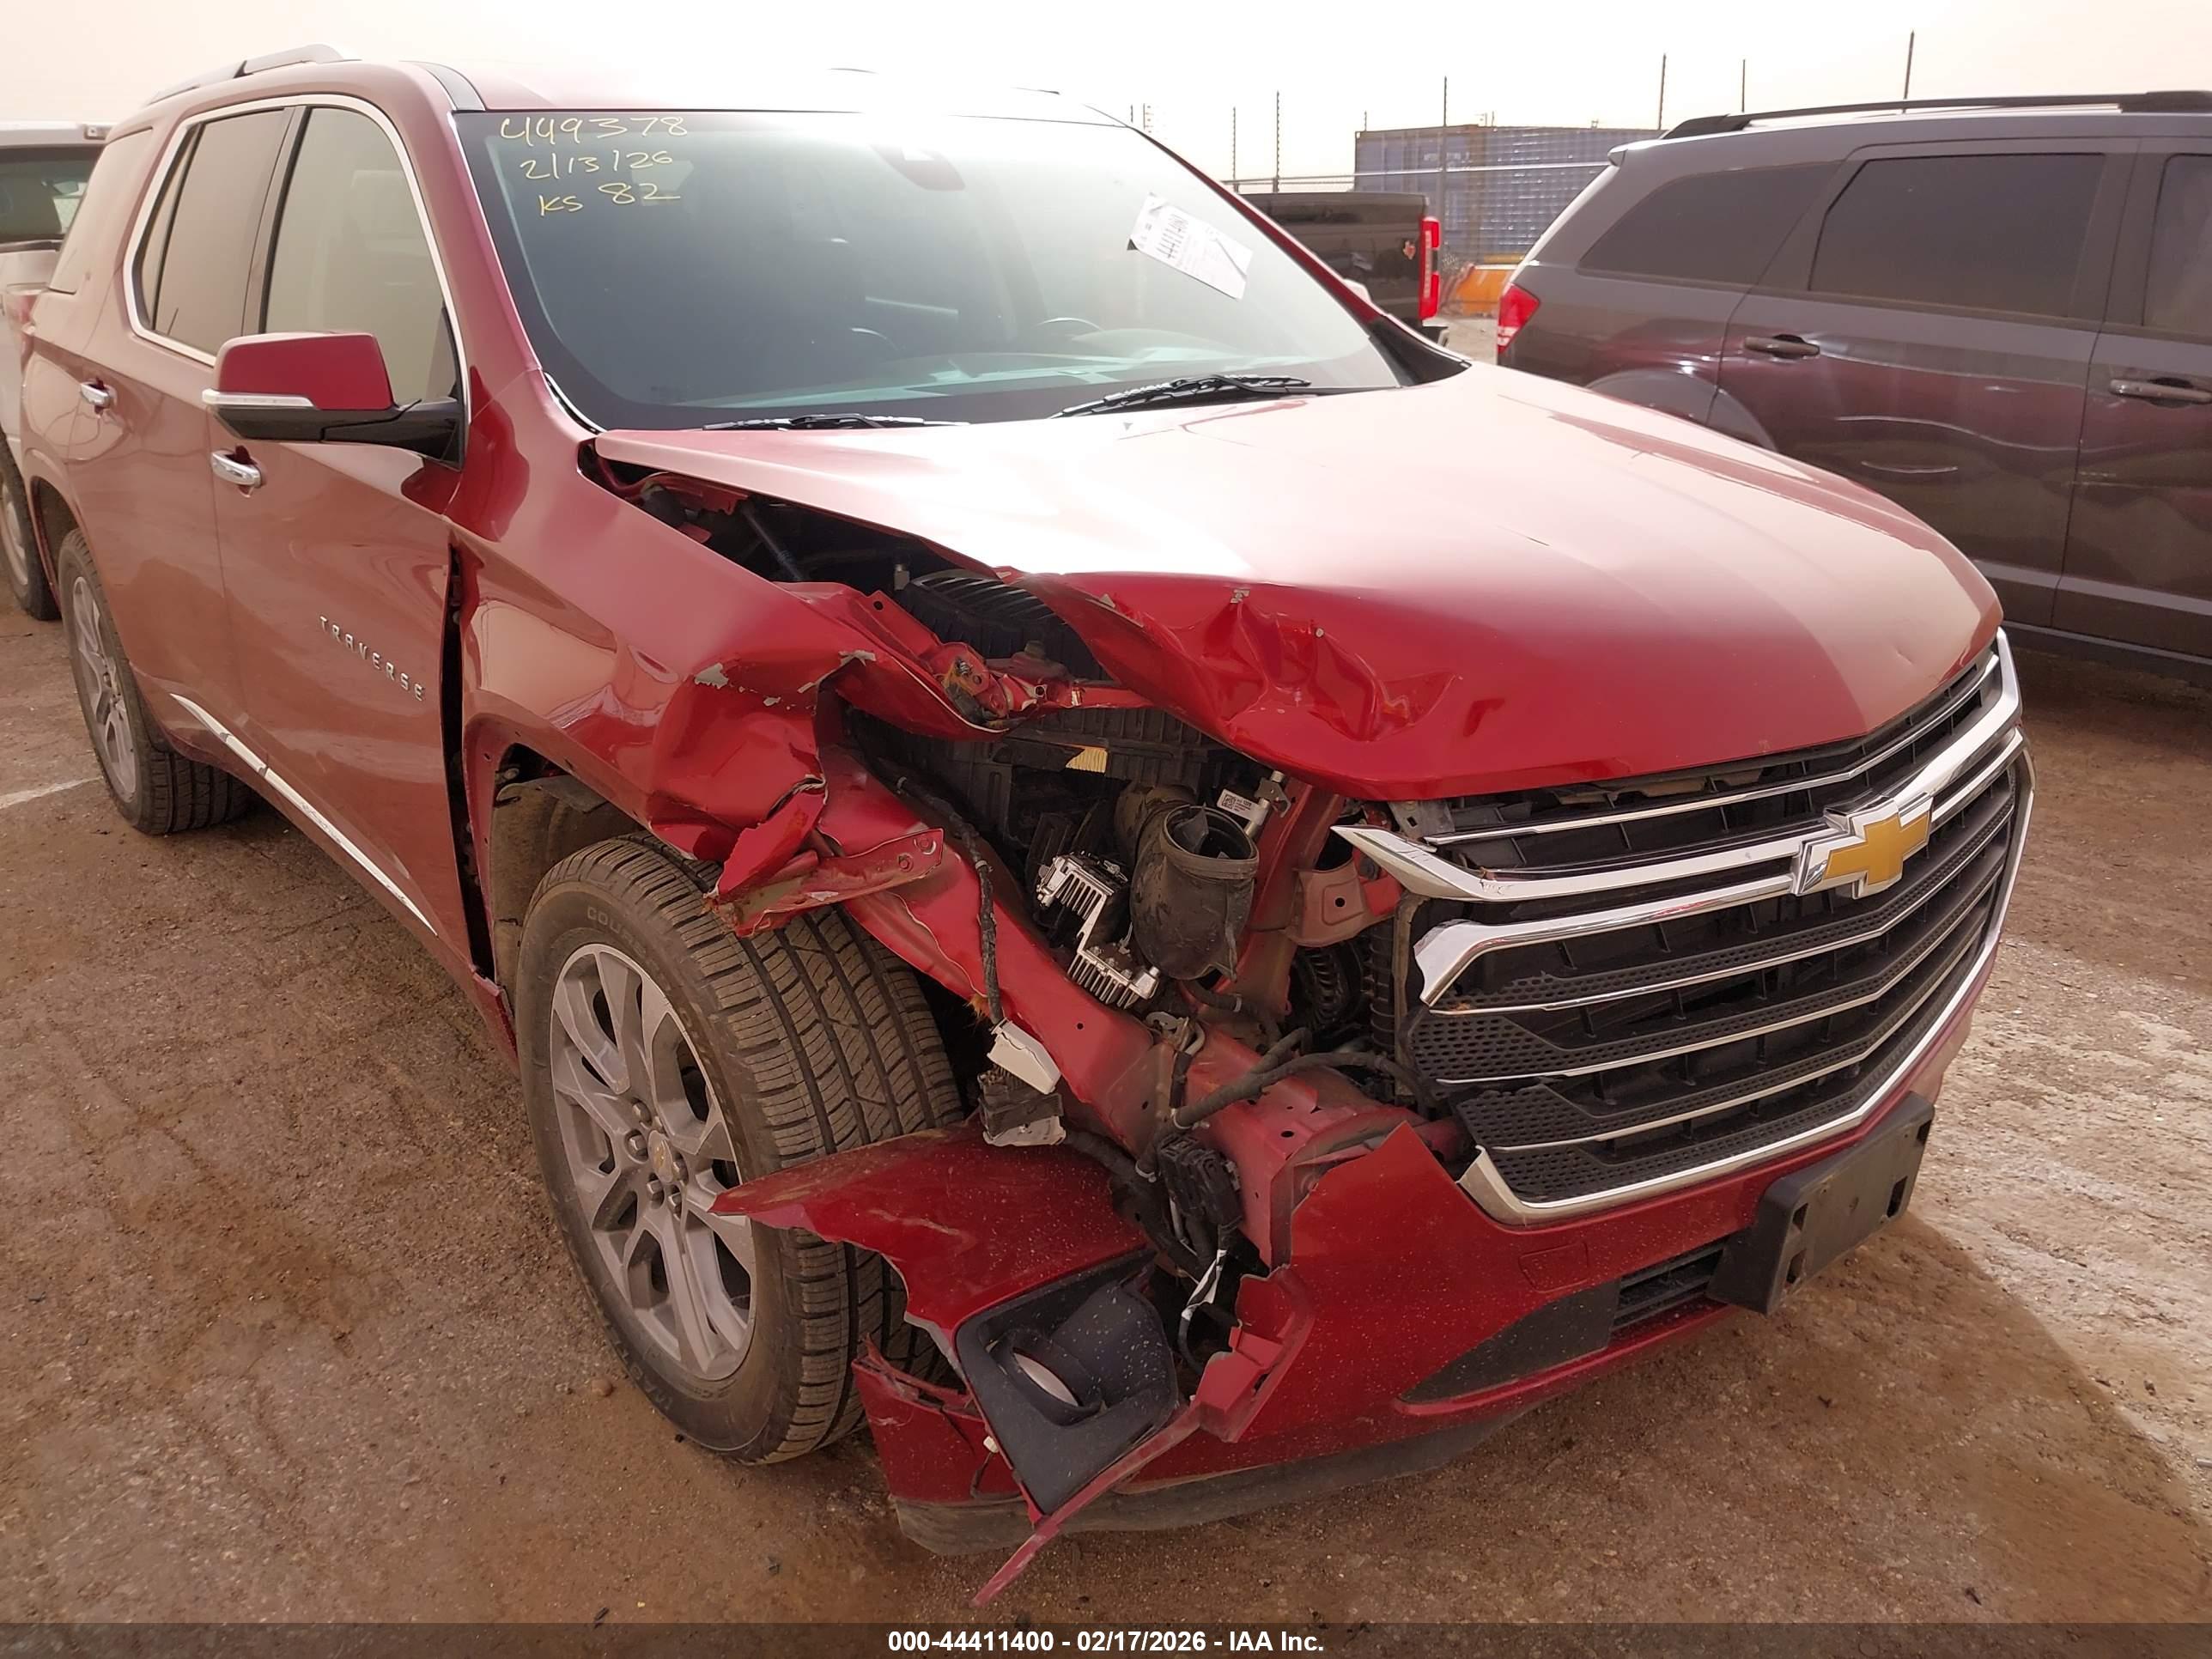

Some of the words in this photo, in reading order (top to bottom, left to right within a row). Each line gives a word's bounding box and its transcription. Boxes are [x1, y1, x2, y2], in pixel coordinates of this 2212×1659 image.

[500, 116, 688, 147] 449378
[598, 182, 681, 204] 82
[319, 615, 424, 702] TRAVERSE
